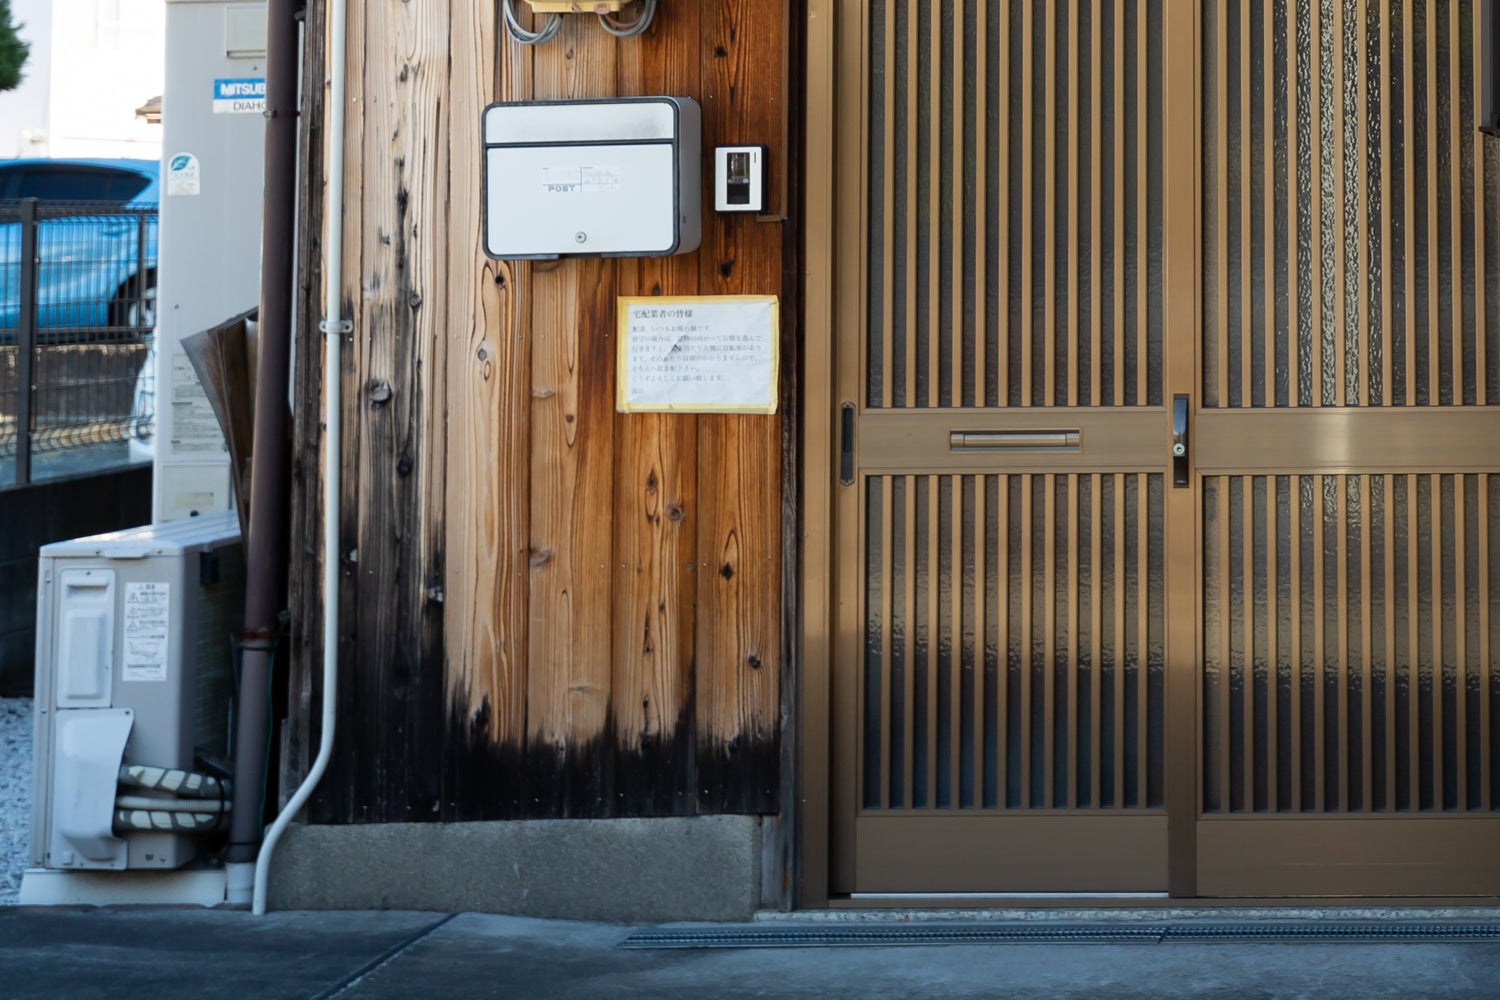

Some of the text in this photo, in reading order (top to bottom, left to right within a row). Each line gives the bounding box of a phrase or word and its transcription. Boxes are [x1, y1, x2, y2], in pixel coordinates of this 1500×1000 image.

[547, 184, 575, 192] POST
[633, 309, 693, 319] 宅配業者の皆様
